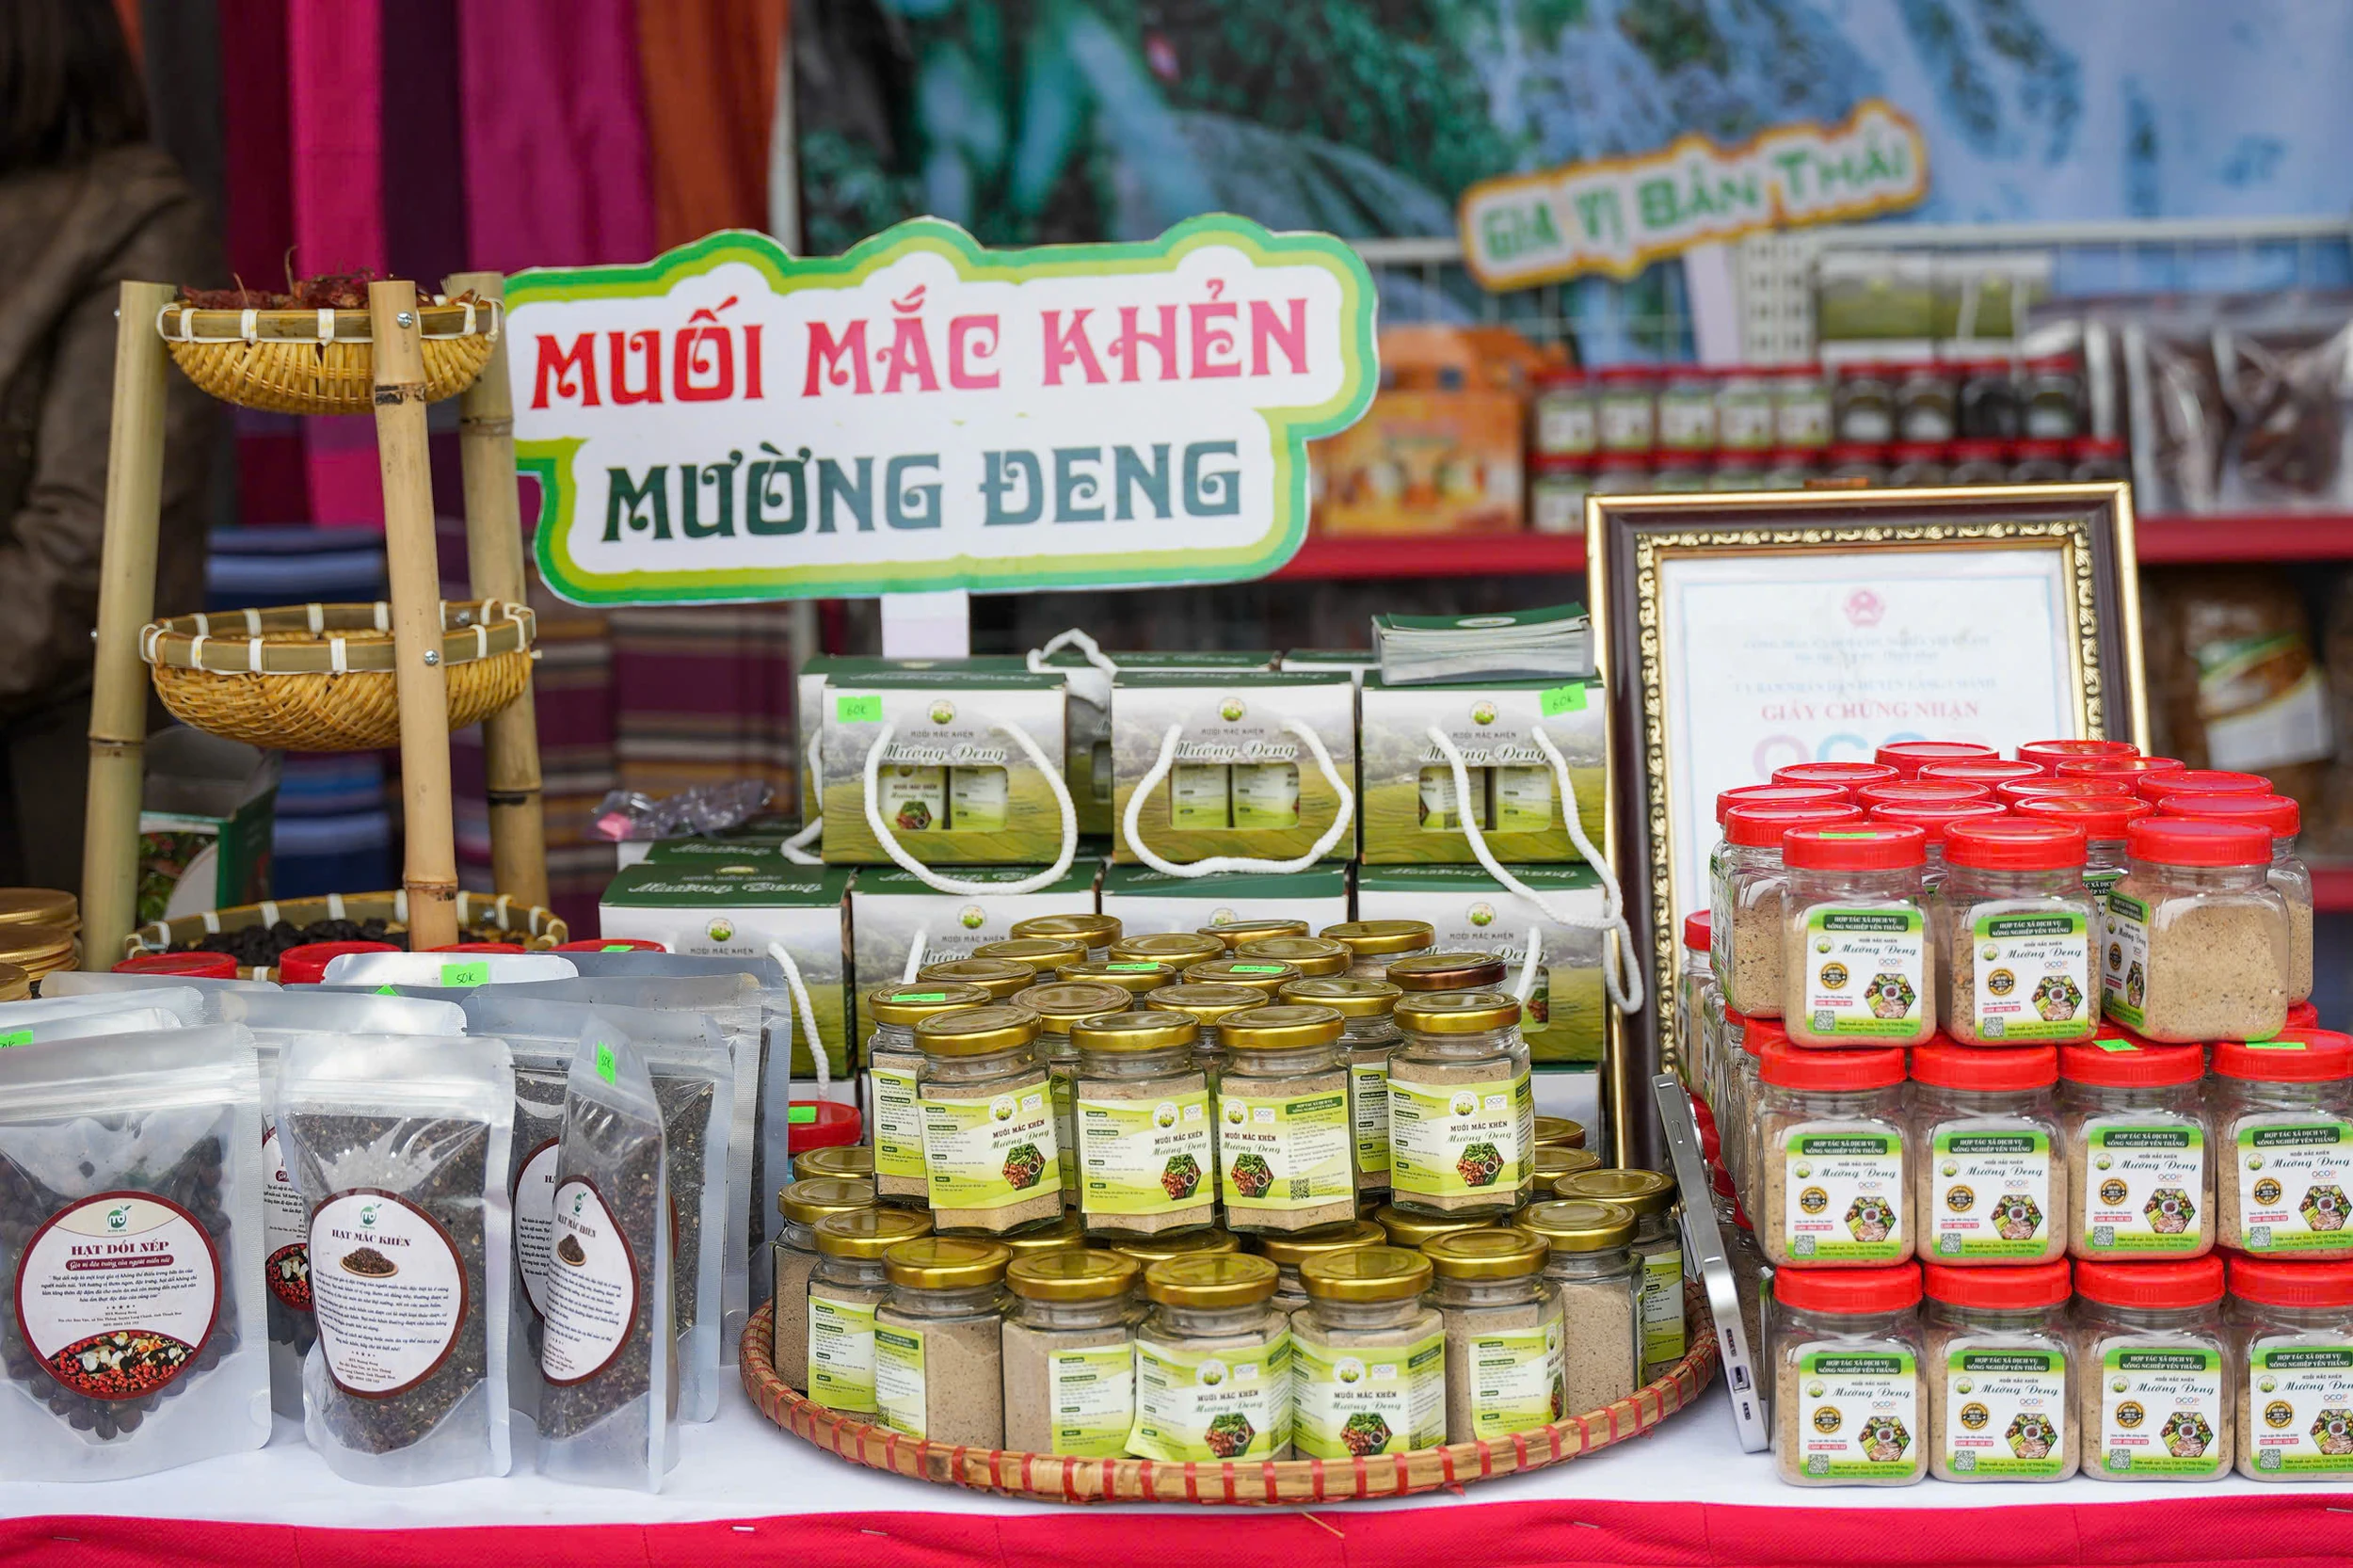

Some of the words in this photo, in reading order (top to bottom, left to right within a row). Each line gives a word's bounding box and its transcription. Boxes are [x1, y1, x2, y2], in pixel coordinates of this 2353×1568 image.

[529, 296, 763, 409] MUỐI
[802, 284, 1000, 397] MẮC
[1041, 279, 1309, 387] KHẺN
[600, 441, 940, 542] MƯỜNG
[979, 440, 1241, 527] ĐENG
[72, 1245, 104, 1257] HẠT
[140, 1239, 169, 1253] NẾP
